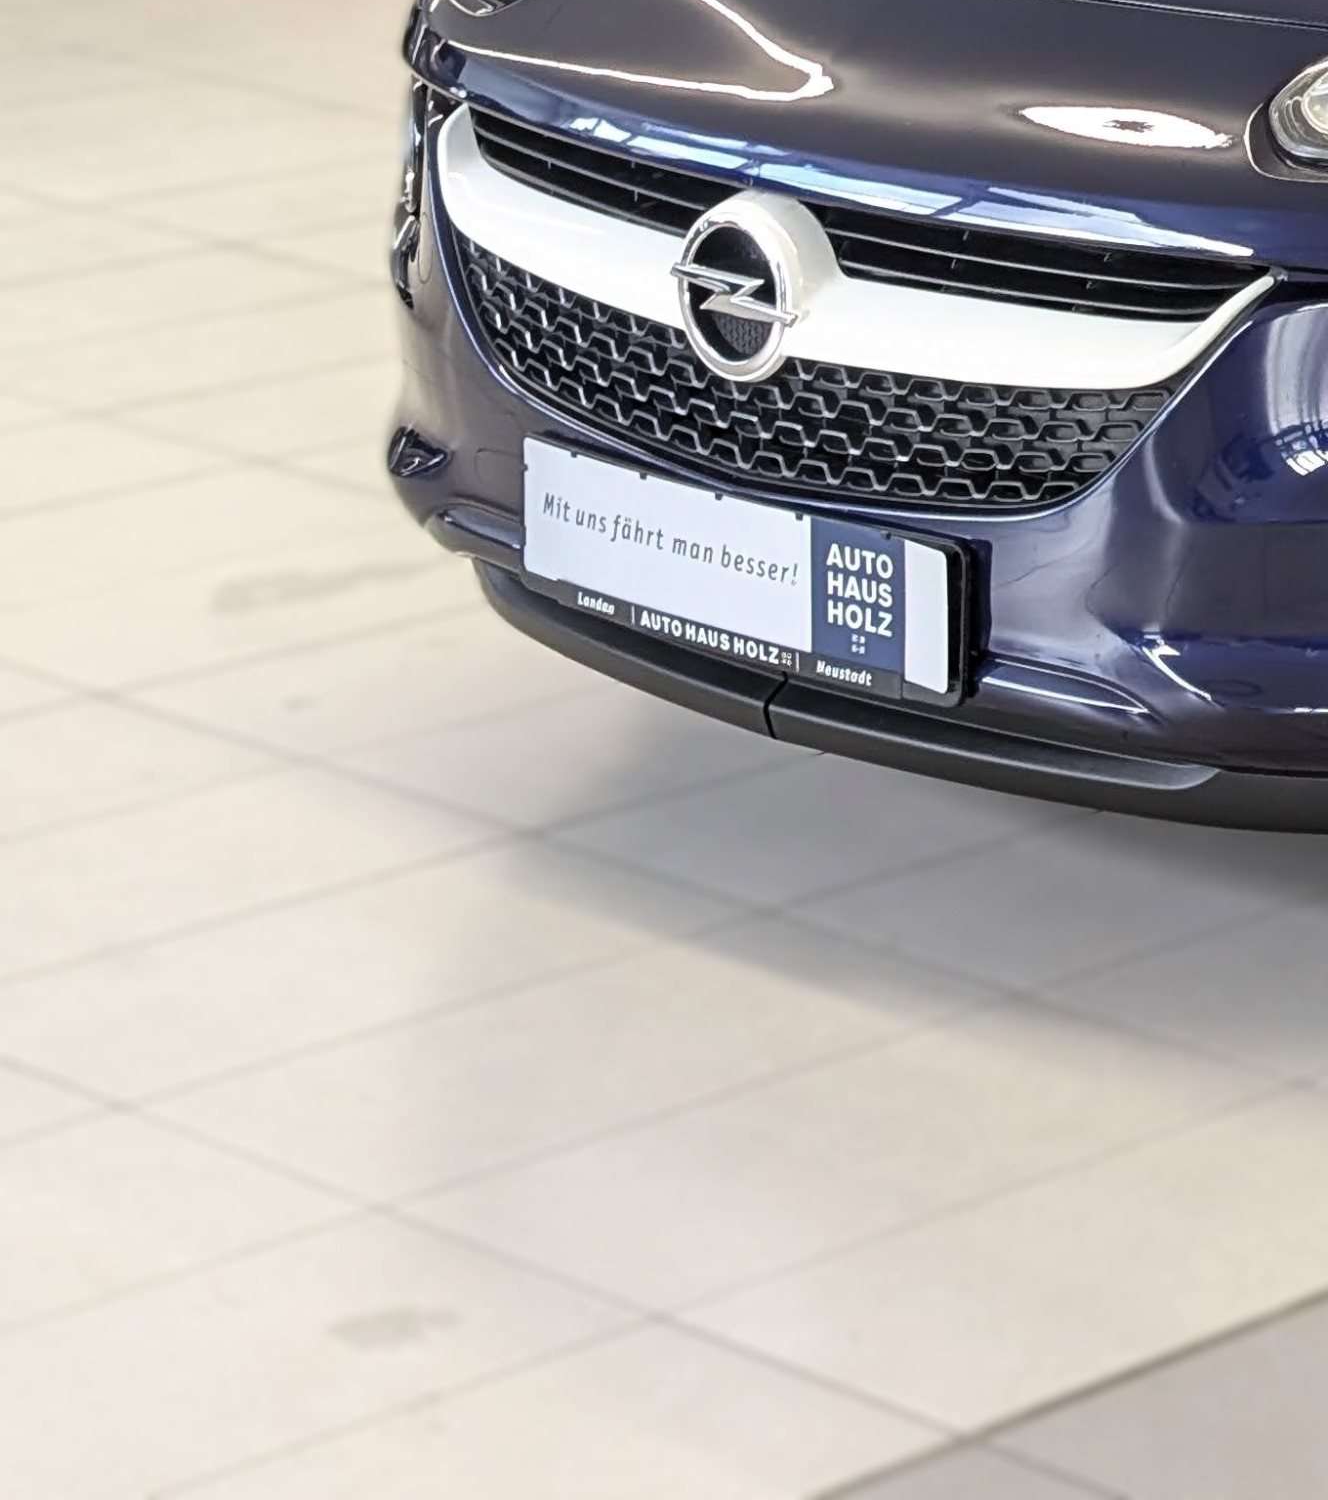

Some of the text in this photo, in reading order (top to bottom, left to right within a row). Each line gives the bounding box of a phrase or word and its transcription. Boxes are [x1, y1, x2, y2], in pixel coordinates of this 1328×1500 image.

[543, 492, 798, 586] Mit uns fährt man besser!
[826, 543, 894, 579] AUTO
[827, 571, 893, 608] HAUS
[640, 609, 683, 637] AUTO
[685, 622, 730, 651] HAUS
[733, 635, 780, 665] HOLZ
[827, 599, 893, 638] HOLZ
